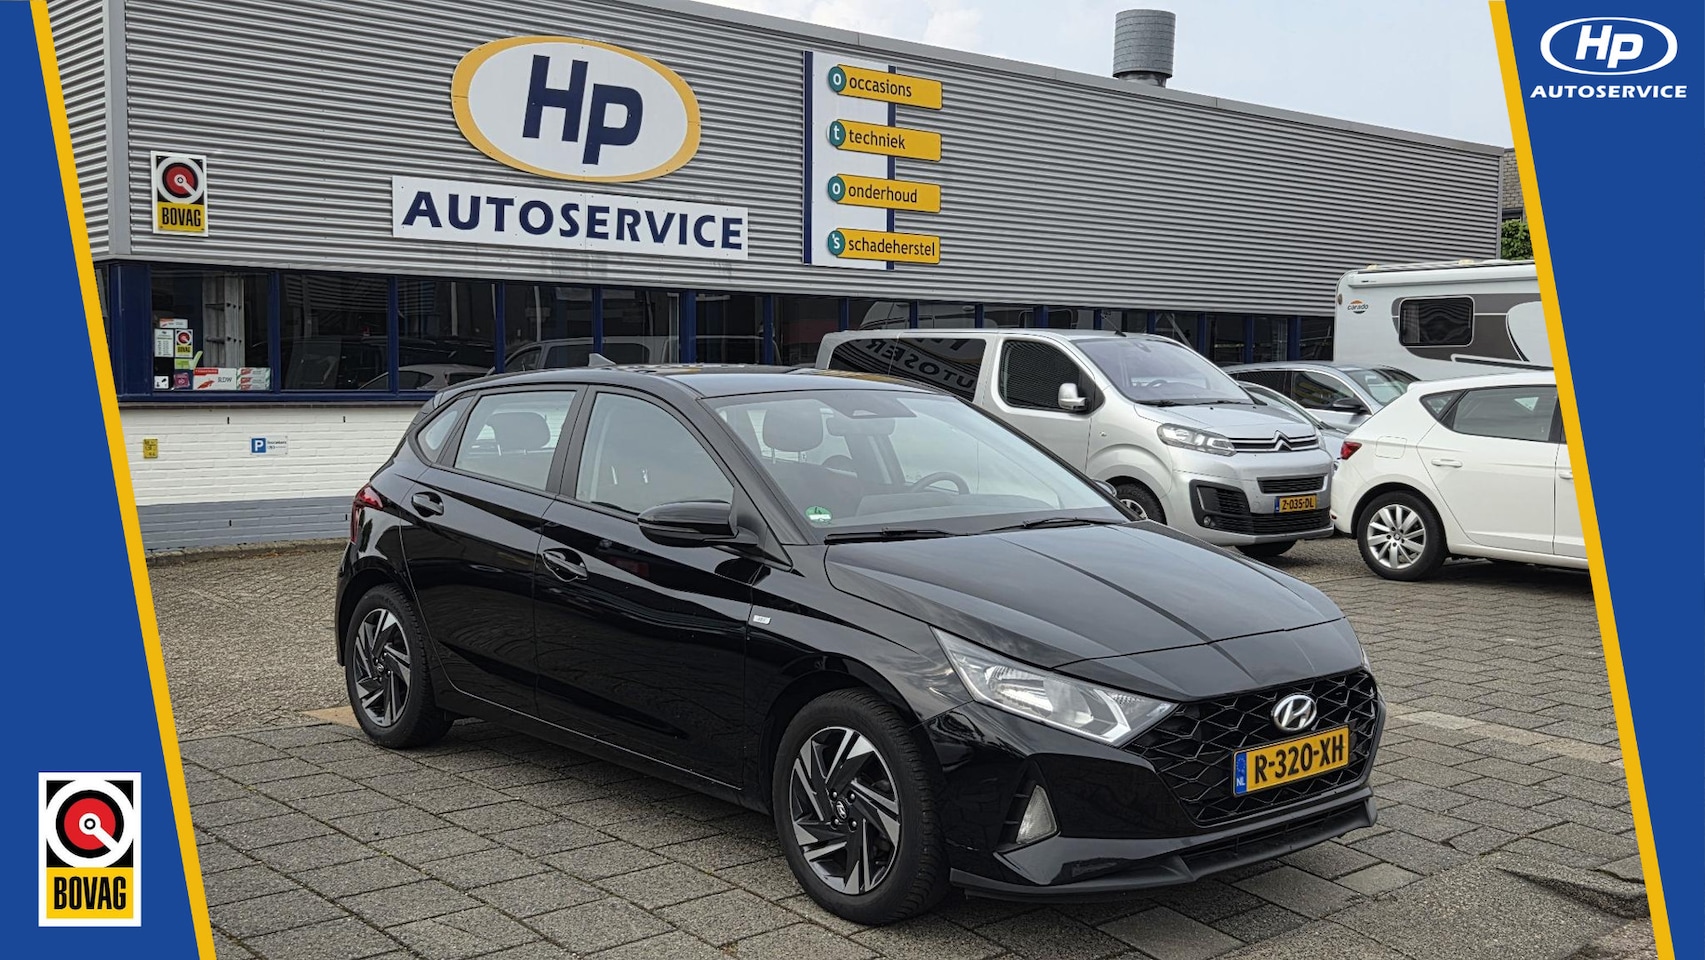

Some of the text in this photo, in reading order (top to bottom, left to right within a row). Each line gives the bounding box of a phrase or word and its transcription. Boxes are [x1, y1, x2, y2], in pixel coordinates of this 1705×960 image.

[849, 75, 912, 98] occasions
[833, 125, 906, 150] t techniek
[848, 185, 918, 203] onderhoud
[161, 206, 201, 227] BOVAG
[402, 191, 743, 250] AUTOSERVICE
[848, 237, 936, 256] schadeherstel
[255, 440, 264, 451] P
[1282, 497, 1314, 510] Z-035-DL
[1236, 734, 1344, 787] NL R-320-XH
